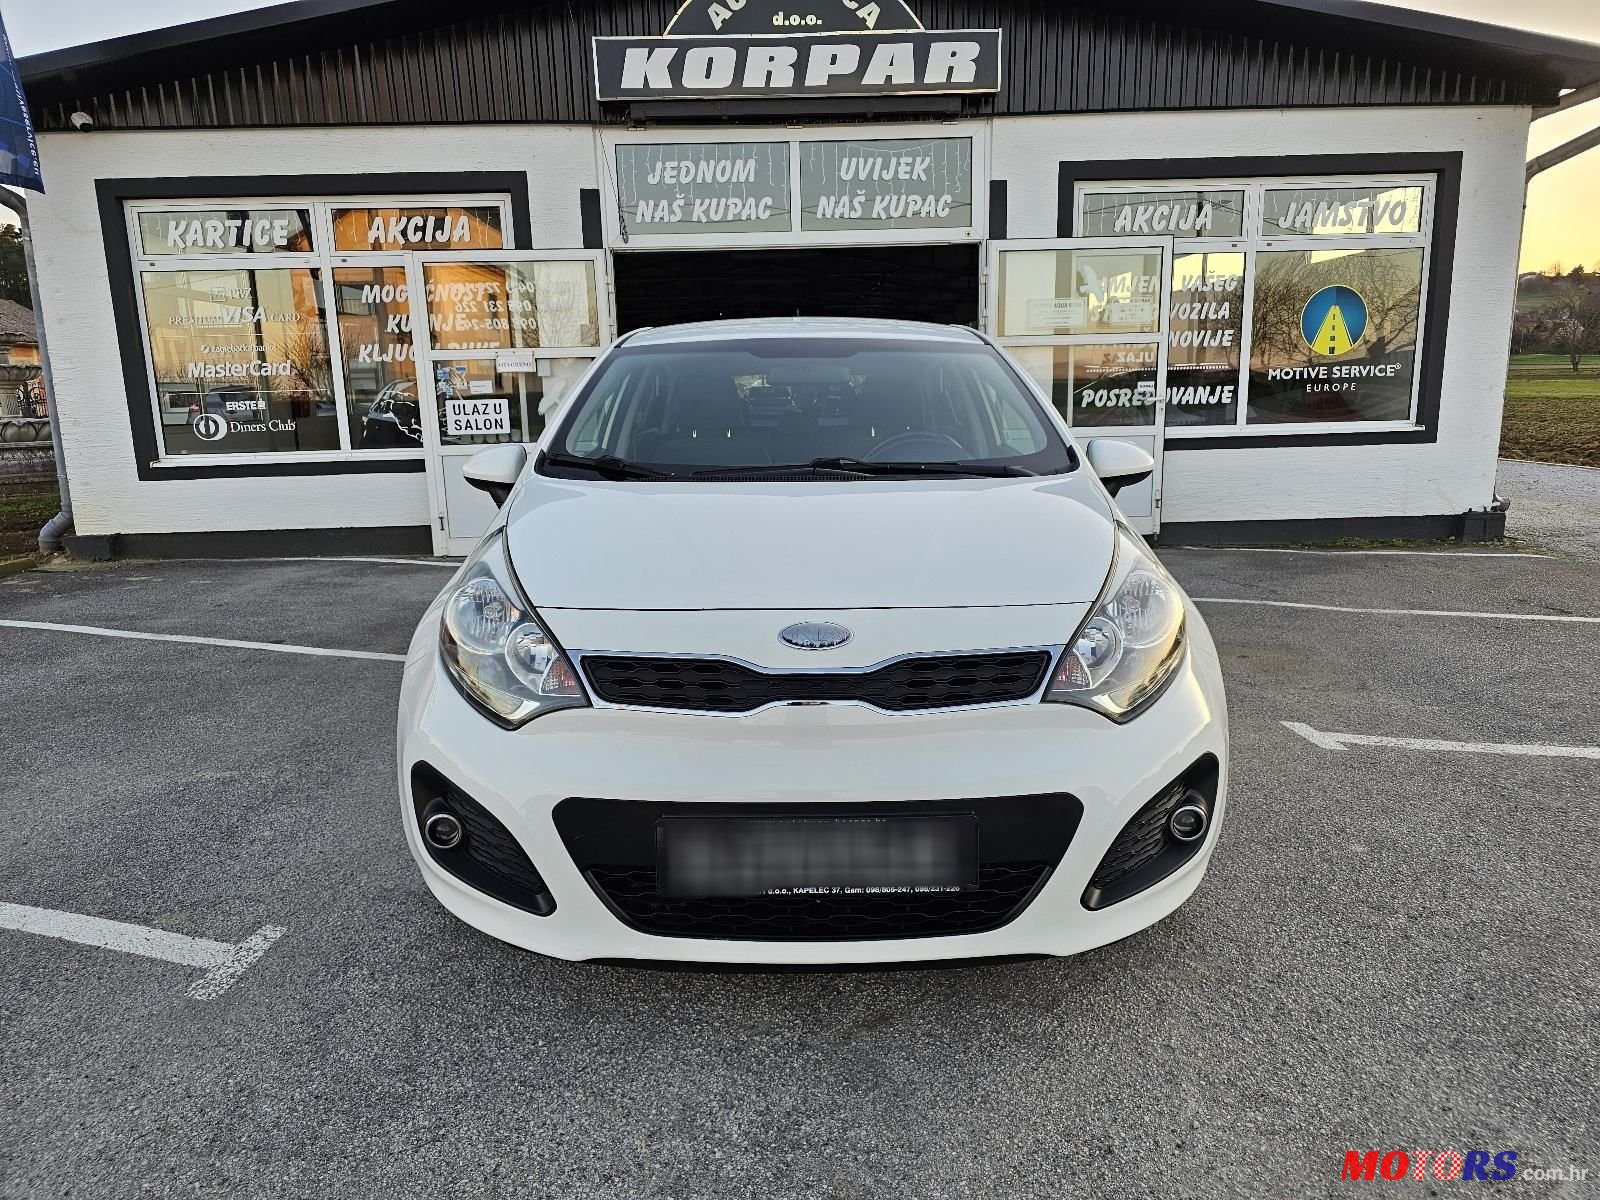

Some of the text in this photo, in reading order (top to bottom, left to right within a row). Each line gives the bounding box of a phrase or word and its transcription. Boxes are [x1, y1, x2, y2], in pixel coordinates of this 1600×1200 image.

[772, 11, 823, 26] d.o.o.
[620, 42, 980, 89] KORPAR
[647, 158, 756, 184] JEDNOM
[840, 157, 931, 182] UVIJEK
[635, 194, 774, 223] NAŠ KUPAC
[816, 190, 953, 219] NAŠ KUPAC
[1277, 200, 1407, 229] JAMSTVO
[367, 215, 471, 245] AKCIJA
[1113, 204, 1213, 234] AKCIJA
[166, 218, 290, 250] KARTICE
[1181, 270, 1238, 293] VAŠEG
[220, 306, 268, 324] VISA
[270, 313, 301, 322] CARD
[387, 313, 467, 334] KUNJE
[187, 360, 292, 378] MasterCard
[1268, 368, 1328, 380] MOTIVE
[1081, 385, 1235, 408] POSREDVANJE
[1306, 383, 1357, 393] EUROPE
[225, 401, 257, 411] ERSTE
[452, 403, 502, 416] ULAZ U
[229, 419, 297, 433] Diners Club
[454, 418, 504, 431] SALON
